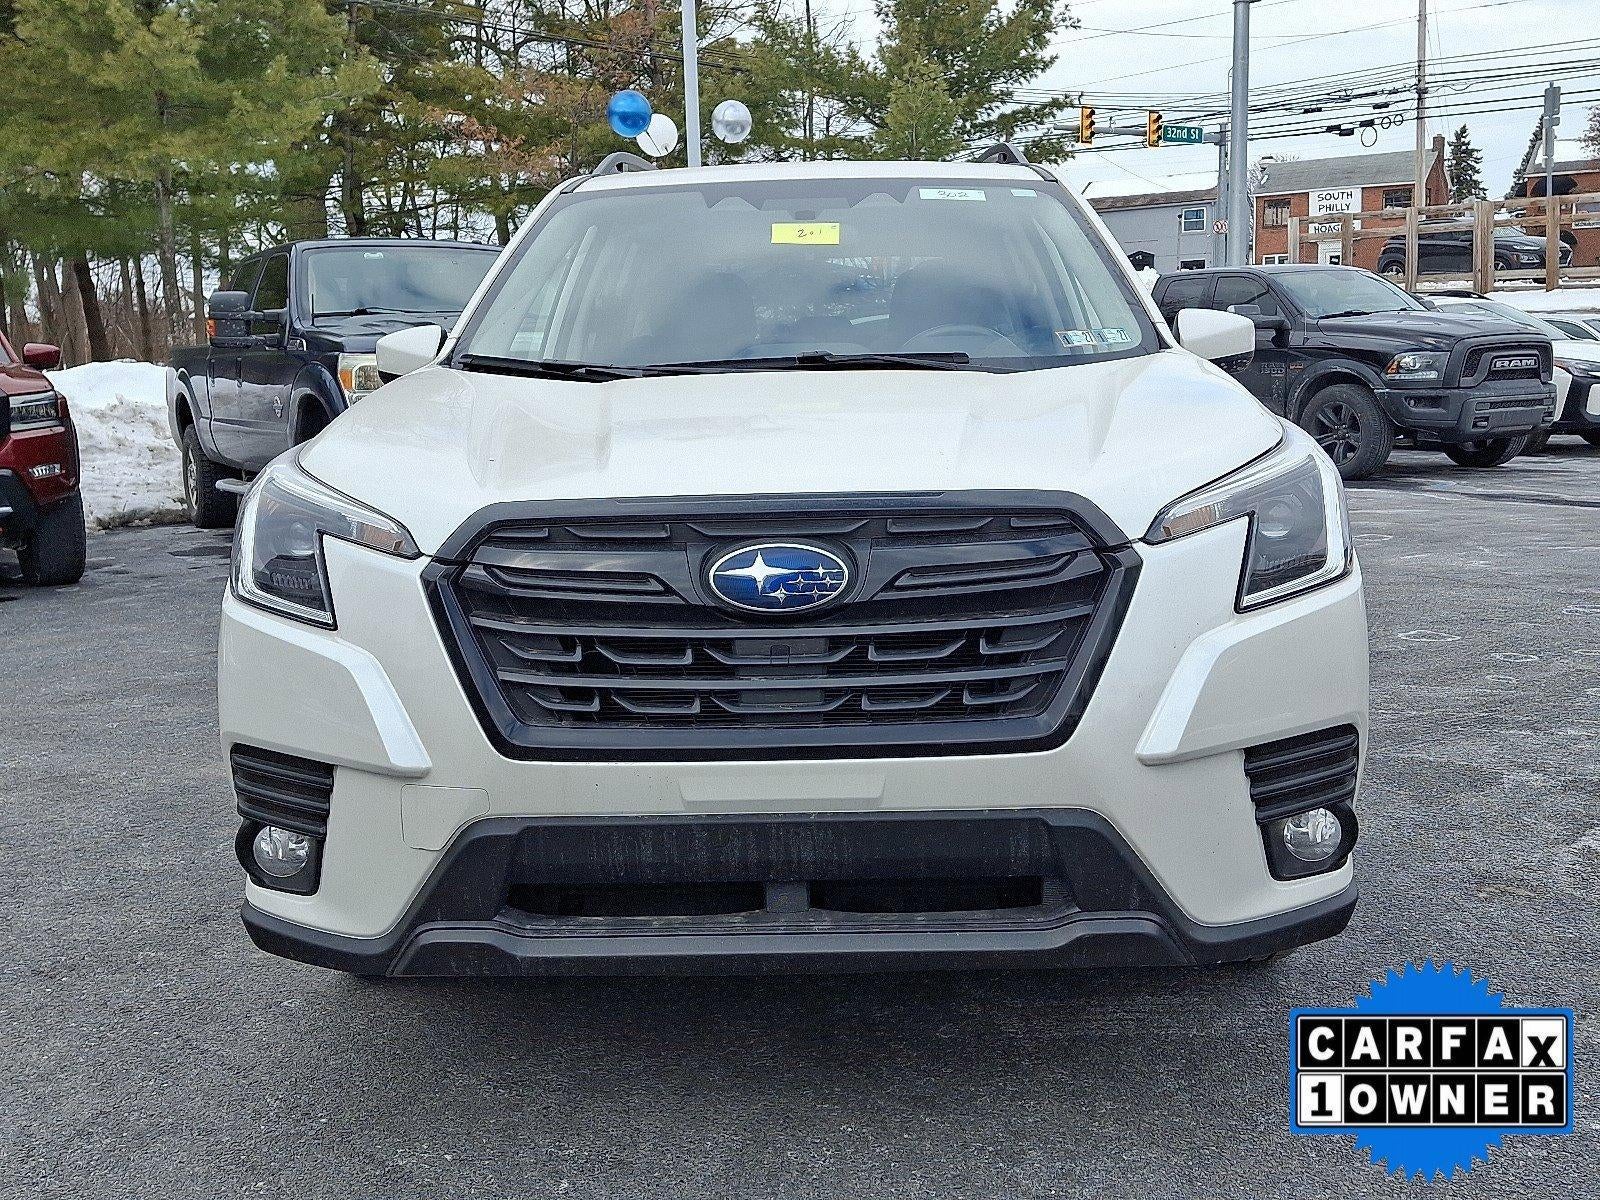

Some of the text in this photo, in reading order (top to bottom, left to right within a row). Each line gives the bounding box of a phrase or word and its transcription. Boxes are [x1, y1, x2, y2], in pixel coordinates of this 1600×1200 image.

[1166, 127, 1187, 139] 32nd
[1317, 191, 1353, 202] SOUTH
[1318, 203, 1351, 212] PHILLY
[1313, 222, 1356, 234] HOAGI
[1495, 359, 1535, 368] RAM
